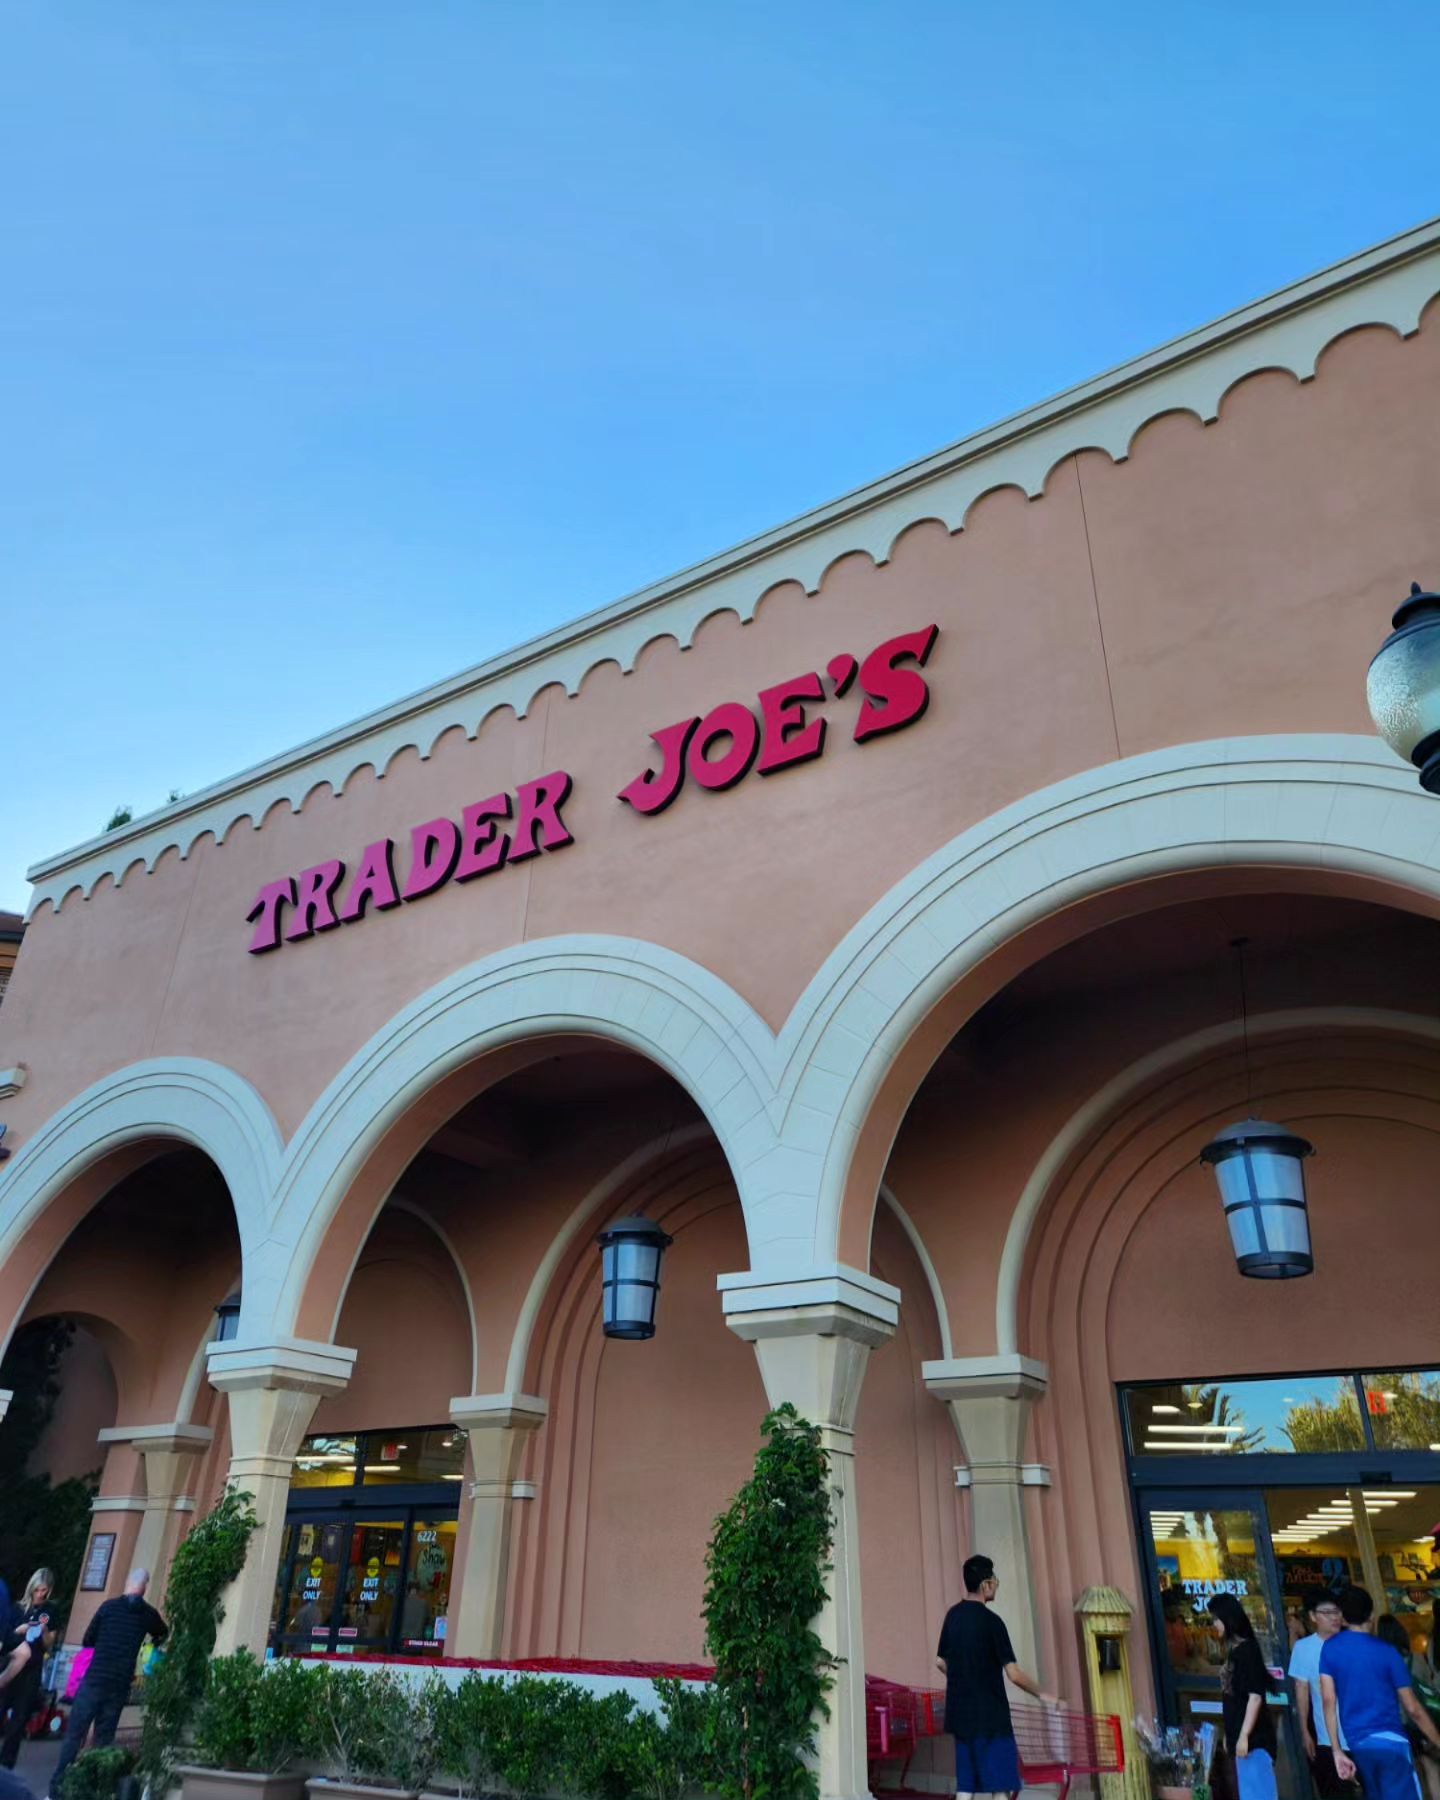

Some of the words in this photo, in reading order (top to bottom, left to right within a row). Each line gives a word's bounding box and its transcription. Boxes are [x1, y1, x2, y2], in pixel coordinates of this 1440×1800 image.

[247, 770, 574, 954] TRADER
[617, 623, 940, 817] JOE'S
[417, 1530, 437, 1542] 6222
[306, 1577, 321, 1588] EXIT
[363, 1577, 380, 1588] EXIT
[1182, 1578, 1249, 1595] TRADER
[303, 1590, 321, 1600] ONLY
[360, 1590, 380, 1601] ONLY
